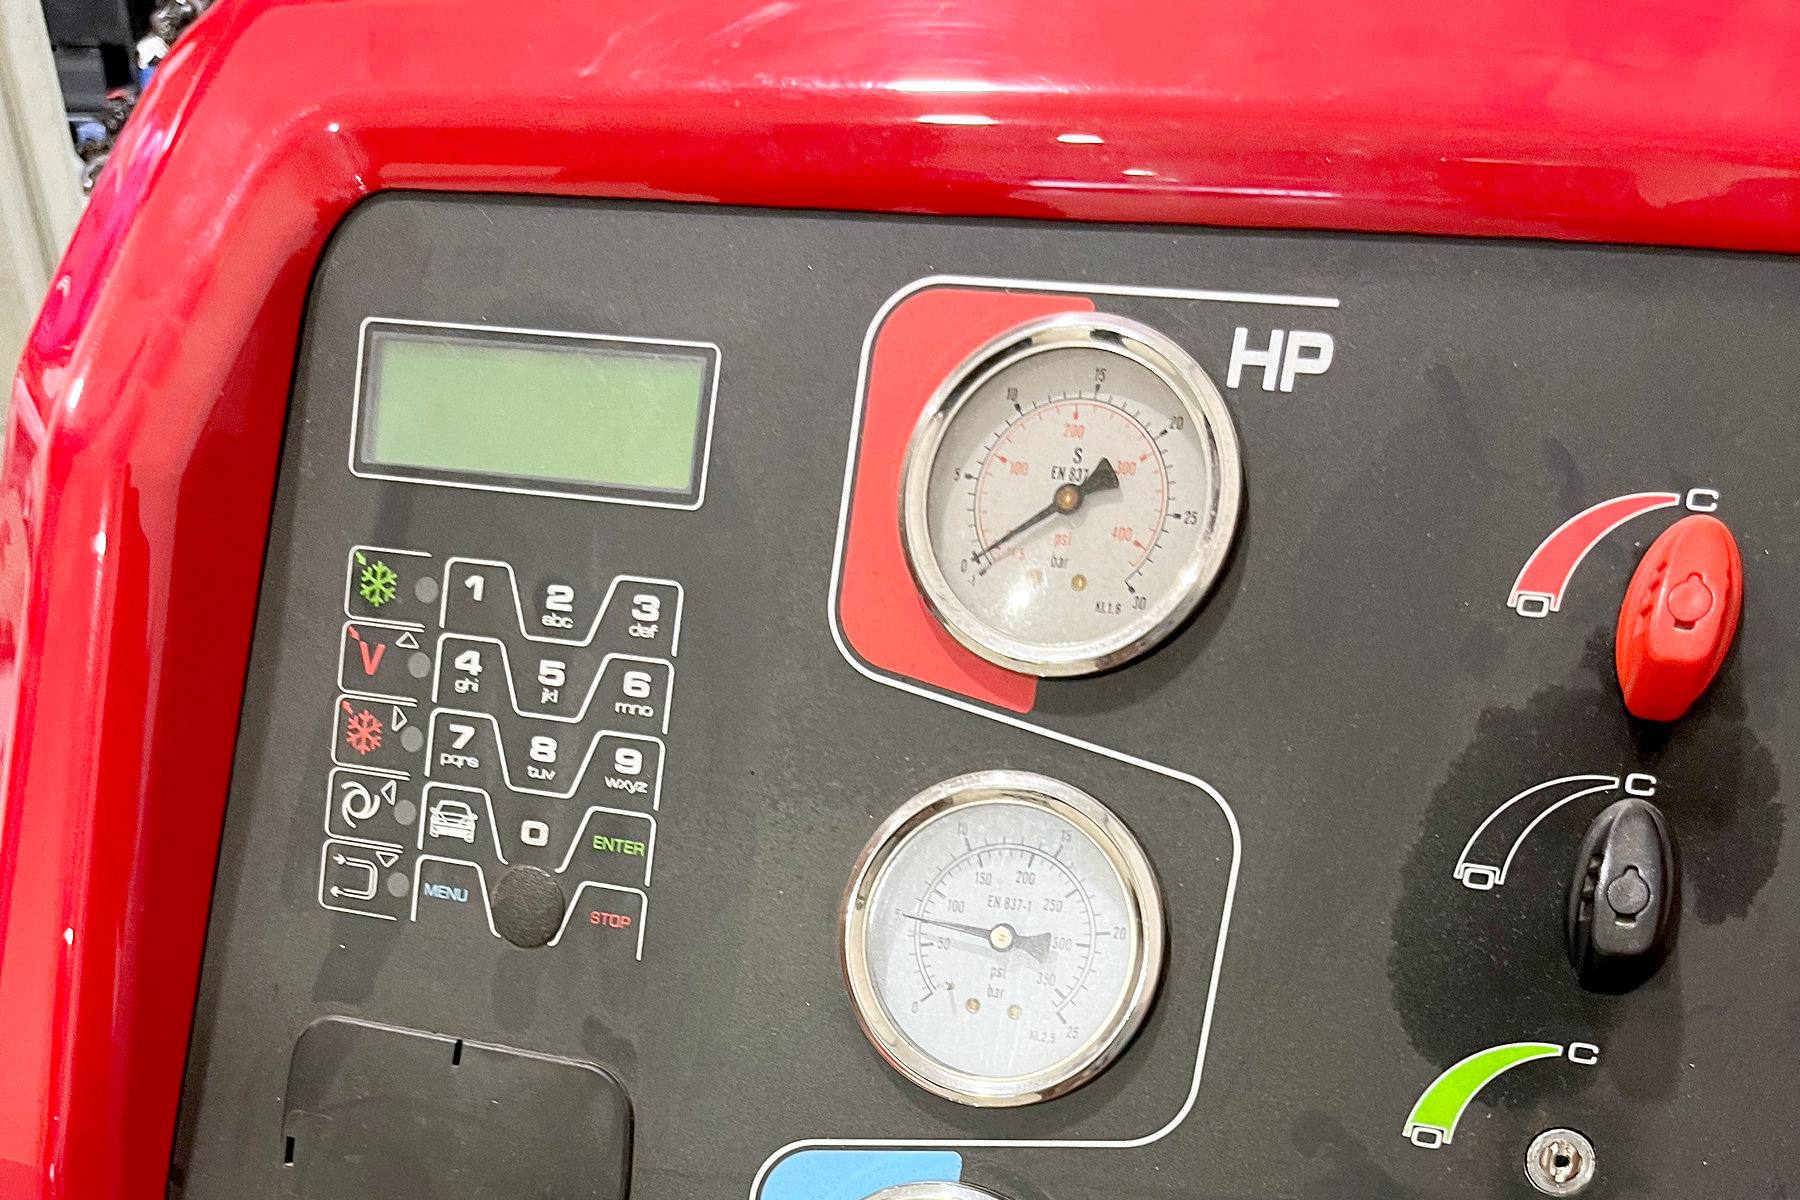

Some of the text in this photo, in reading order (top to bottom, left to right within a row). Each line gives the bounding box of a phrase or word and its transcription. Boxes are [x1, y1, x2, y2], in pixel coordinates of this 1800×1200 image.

[1226, 327, 1335, 392] HP
[1094, 367, 1107, 384] 15
[1062, 424, 1086, 439] 200
[1073, 447, 1084, 464] S
[1051, 466, 1064, 480] EN
[1184, 510, 1198, 525] 25
[464, 574, 485, 602] 1
[545, 584, 575, 613] 2
[1132, 596, 1147, 610] 30
[631, 594, 661, 623] 3
[541, 613, 574, 630] abc
[628, 623, 660, 640] def
[454, 649, 484, 677] 4
[538, 659, 567, 687] 5
[454, 678, 480, 695] ghi
[622, 670, 652, 699] 6
[540, 688, 559, 705] jkl
[614, 701, 655, 719] mno
[448, 723, 476, 750] 7
[529, 735, 559, 763] 8
[440, 752, 480, 770] pqrs
[614, 747, 644, 777] 9
[527, 765, 557, 781] tuv
[604, 776, 650, 795] wxyz
[519, 819, 550, 848] 0
[592, 834, 646, 858] ENTER
[975, 872, 992, 886] 150
[1015, 870, 1035, 885] 200
[423, 882, 469, 903] MENU
[947, 899, 965, 913] 100
[1043, 898, 1063, 912] 250
[589, 911, 632, 929] STOP
[1113, 926, 1126, 940] 20
[1066, 1025, 1080, 1040] 25
